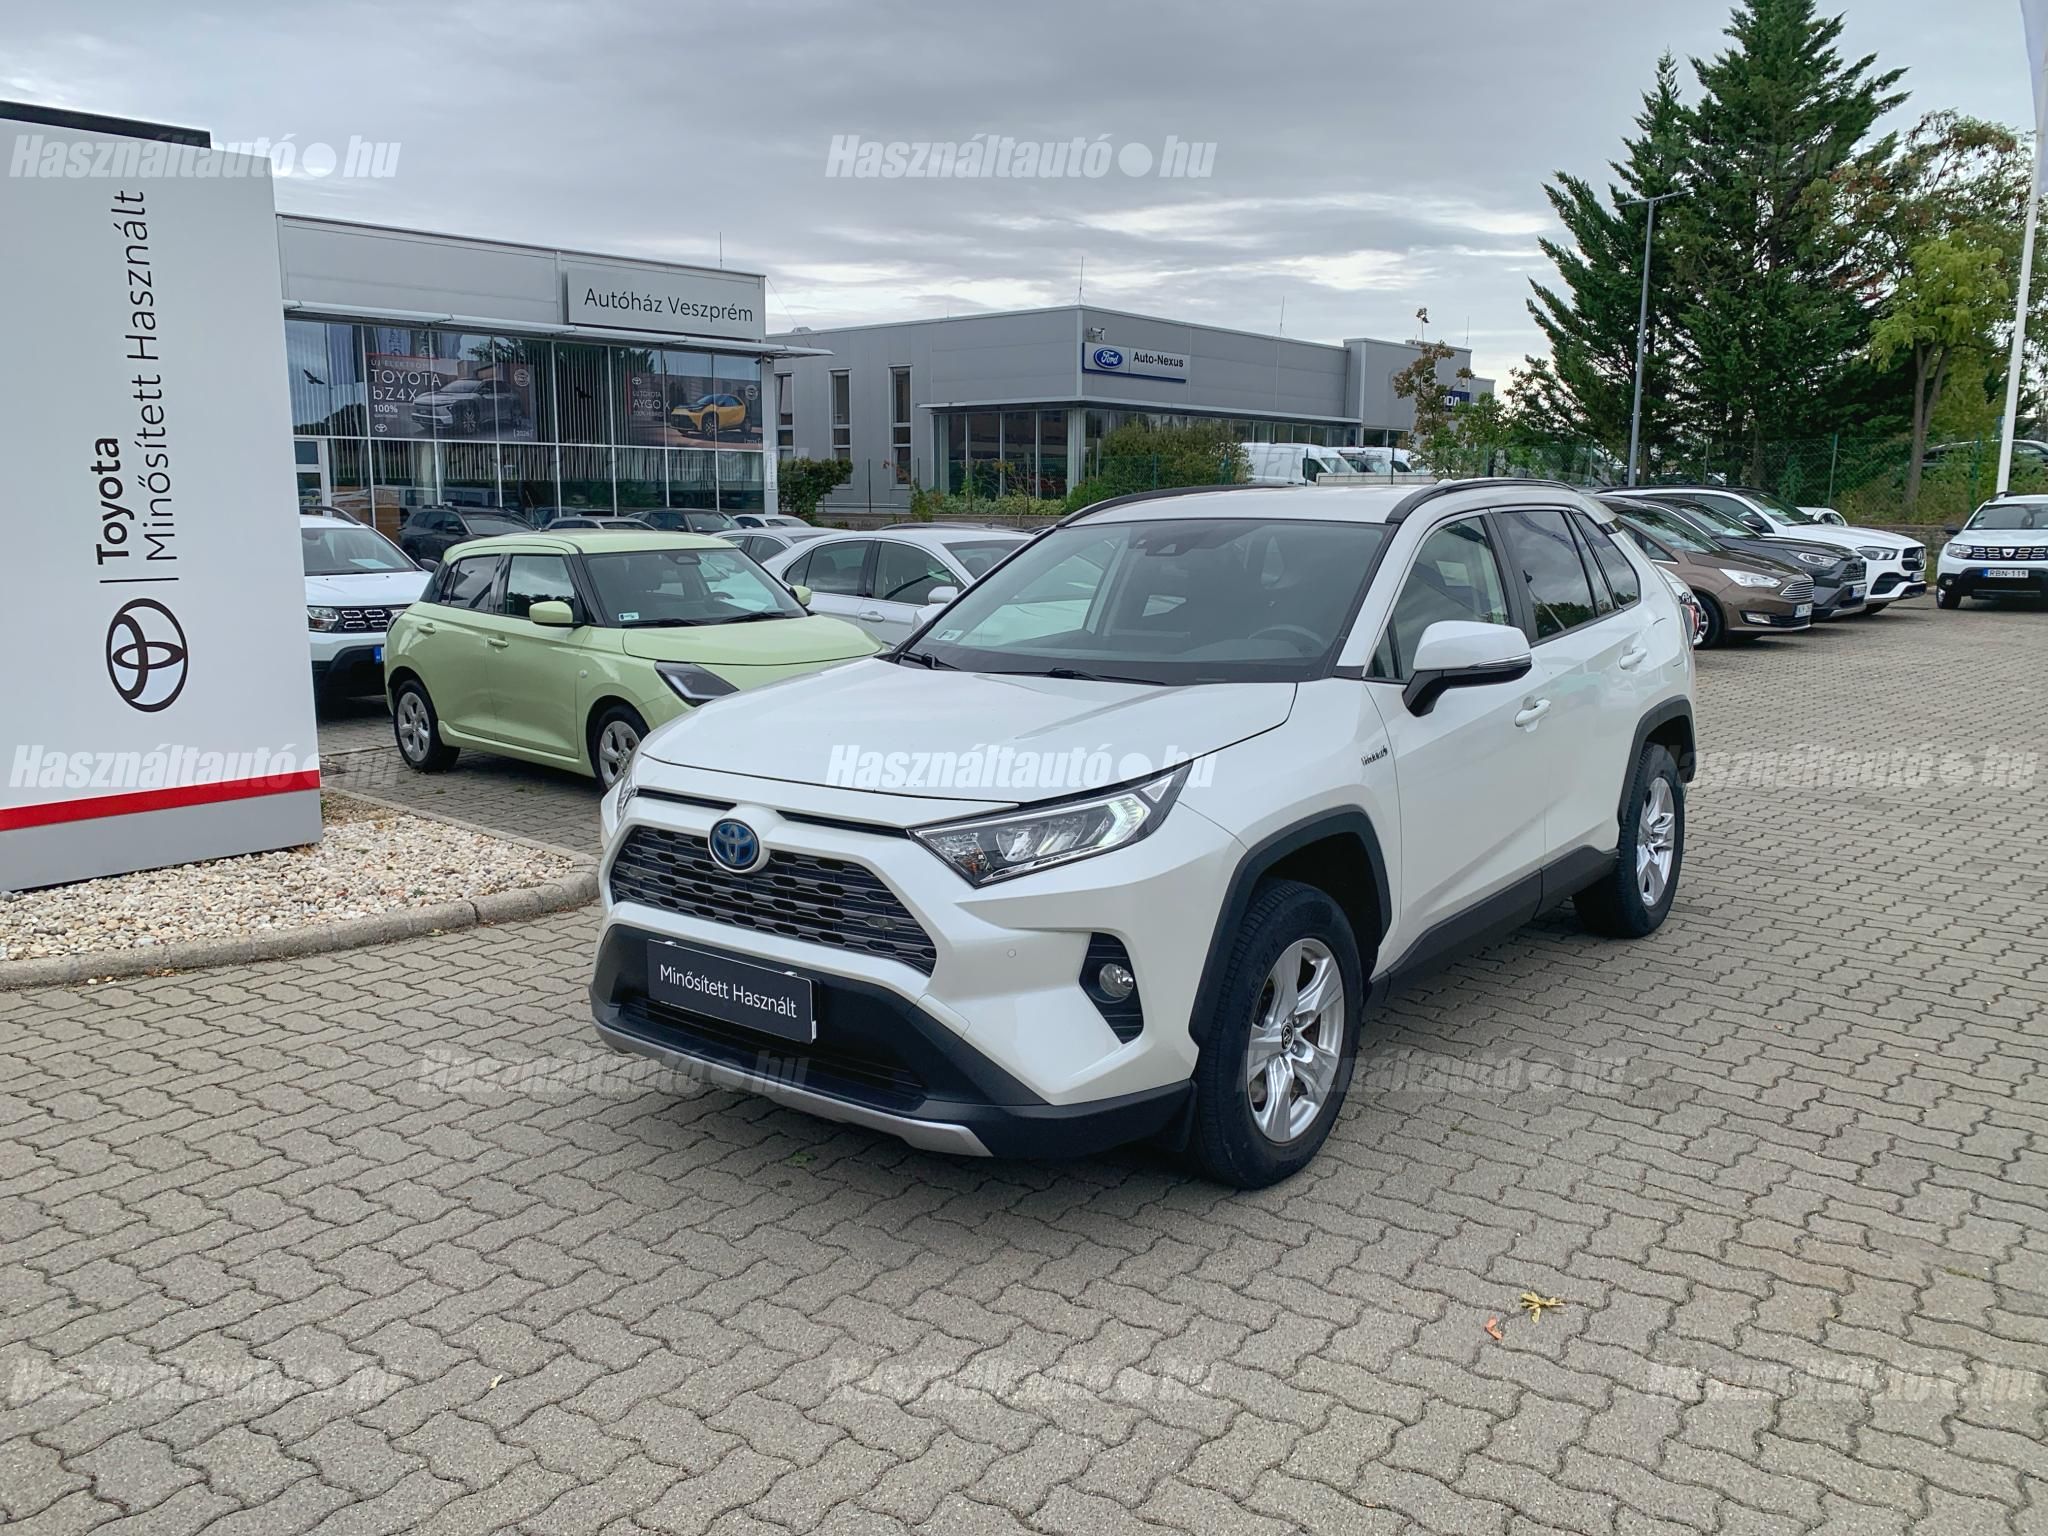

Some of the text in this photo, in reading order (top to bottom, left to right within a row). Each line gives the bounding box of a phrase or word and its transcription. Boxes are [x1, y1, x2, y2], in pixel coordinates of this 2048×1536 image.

[584, 288, 753, 322] Autóház Veszprém
[1101, 350, 1119, 364] Ford
[1134, 352, 1184, 367] Auto-Nexus
[111, 190, 177, 560] Minősített Használt
[370, 369, 441, 387] TOYOTA
[373, 386, 417, 401] bZ4X
[374, 405, 398, 413] 100%
[633, 399, 661, 409] AYGO
[90, 438, 135, 565] Toyota
[660, 964, 797, 1018] Minősített Használt
